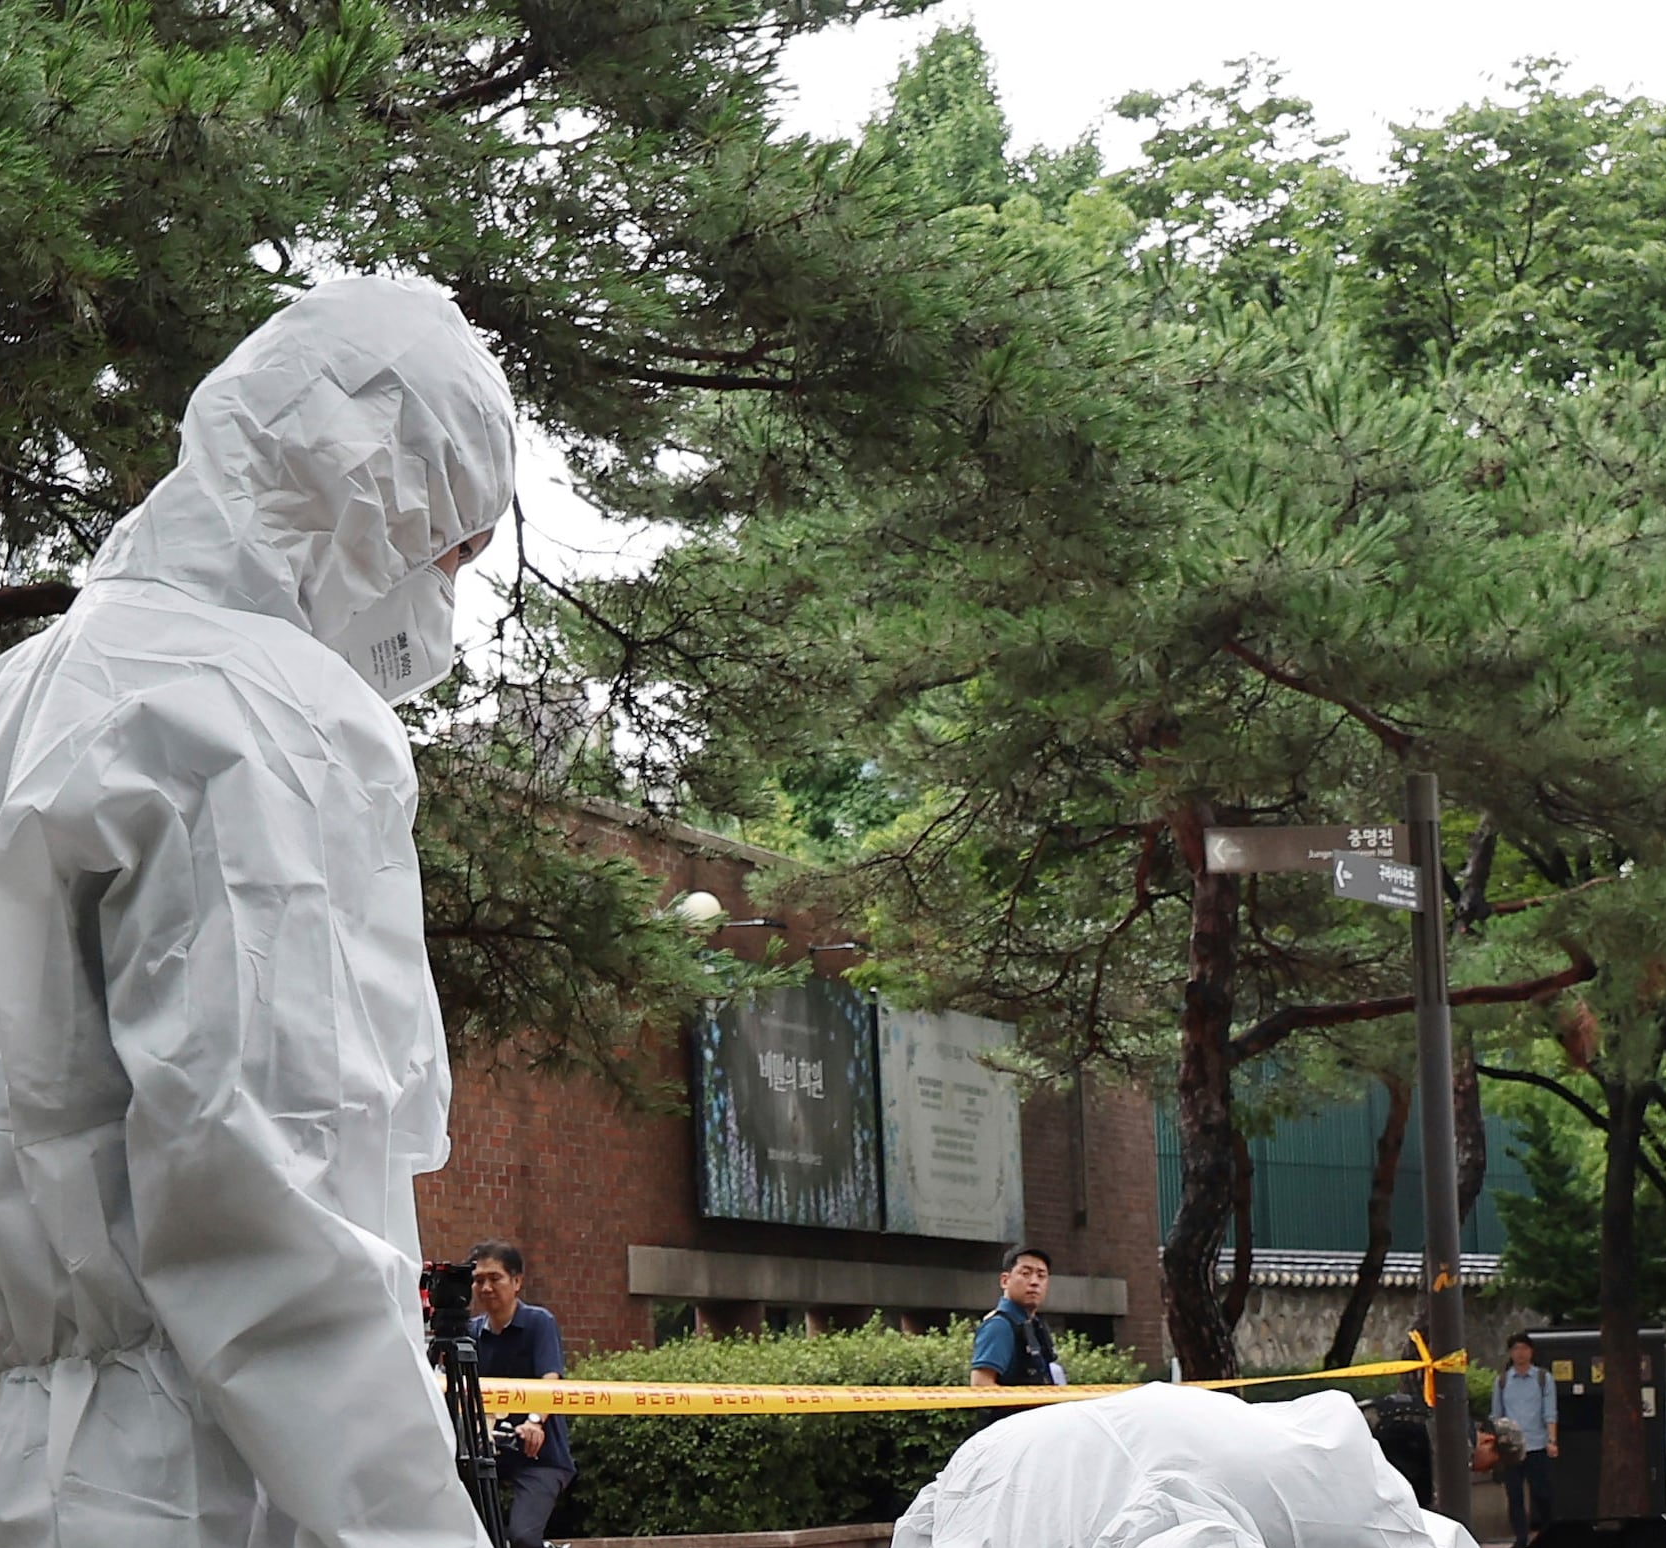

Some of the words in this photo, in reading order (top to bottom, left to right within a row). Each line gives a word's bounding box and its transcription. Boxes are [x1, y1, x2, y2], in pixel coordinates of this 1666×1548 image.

[397, 631, 408, 651] 3M
[401, 652, 412, 679] 9002
[1347, 828, 1393, 848] 중명전
[757, 1049, 797, 1093] 비밀의
